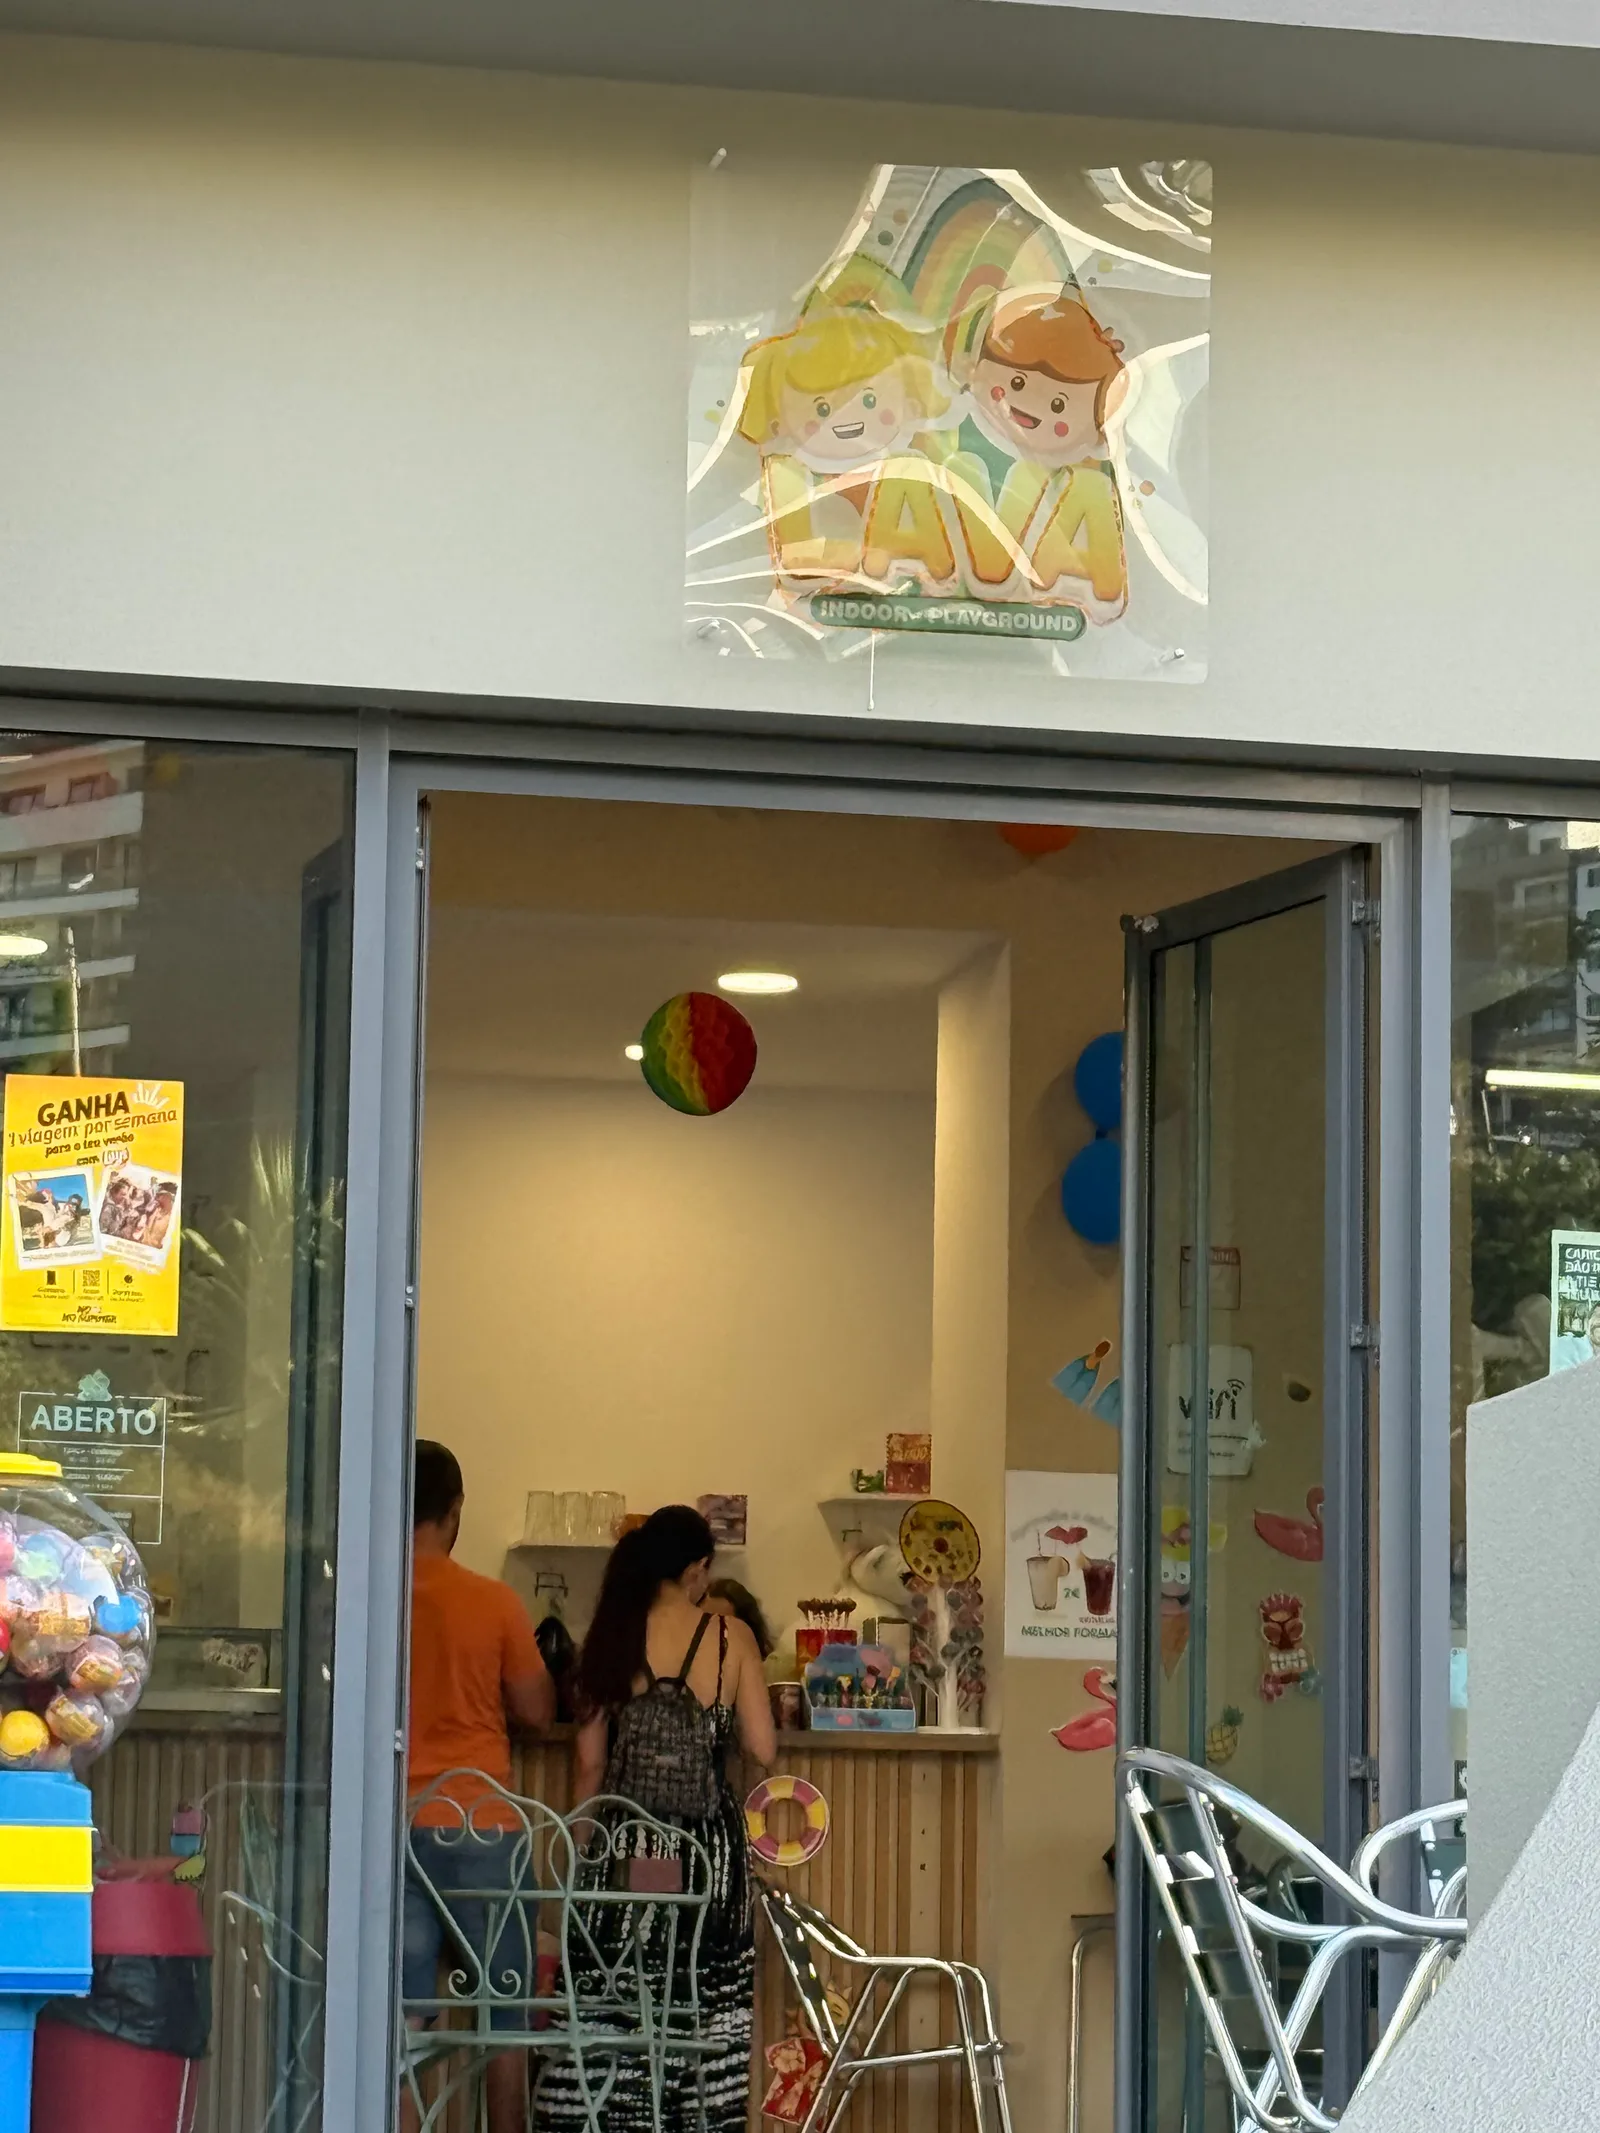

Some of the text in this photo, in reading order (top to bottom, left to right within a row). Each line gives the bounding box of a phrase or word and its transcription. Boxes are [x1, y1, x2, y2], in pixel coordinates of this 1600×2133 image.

[821, 600, 1077, 632] INDOOR PLAYGROUND
[37, 1091, 130, 1127] GANHA
[19, 1125, 79, 1145] viagem
[84, 1120, 112, 1139] por
[115, 1109, 178, 1130] semana
[31, 1404, 157, 1435] ABERTO
